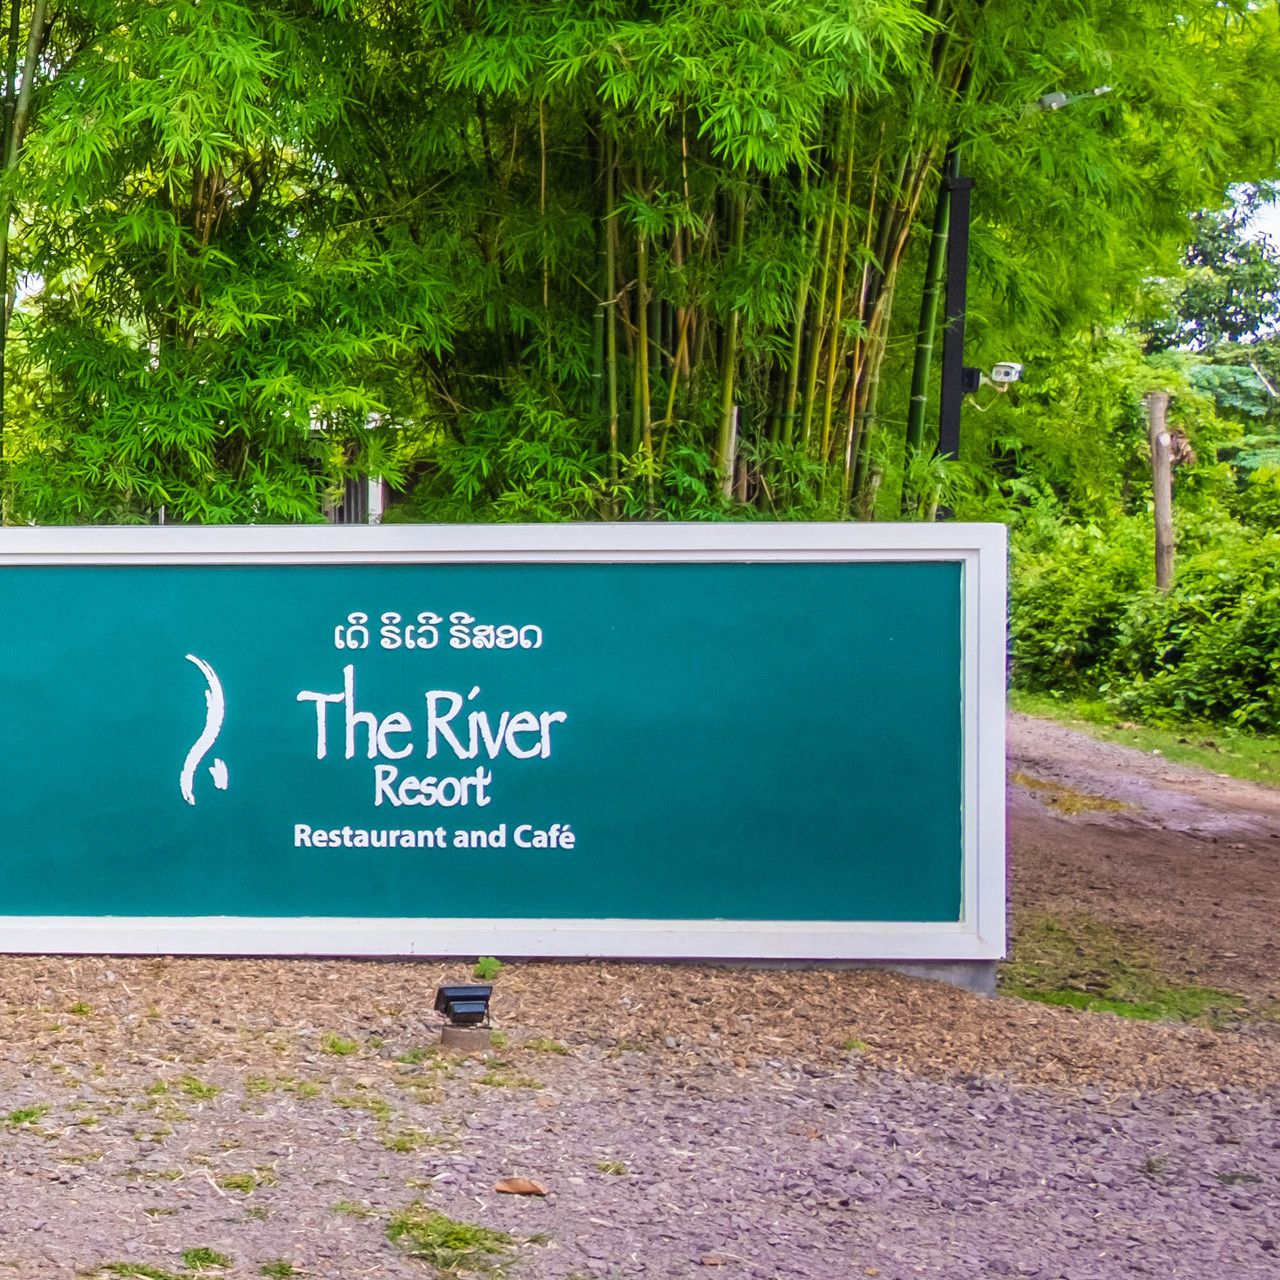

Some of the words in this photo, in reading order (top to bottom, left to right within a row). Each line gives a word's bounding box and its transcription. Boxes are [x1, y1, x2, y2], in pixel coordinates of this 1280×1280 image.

[296, 663, 414, 760] The
[424, 685, 568, 760] River
[374, 764, 492, 807] Resort
[294, 823, 447, 849] Restaurant
[453, 823, 507, 849] and
[513, 823, 576, 850] Café
